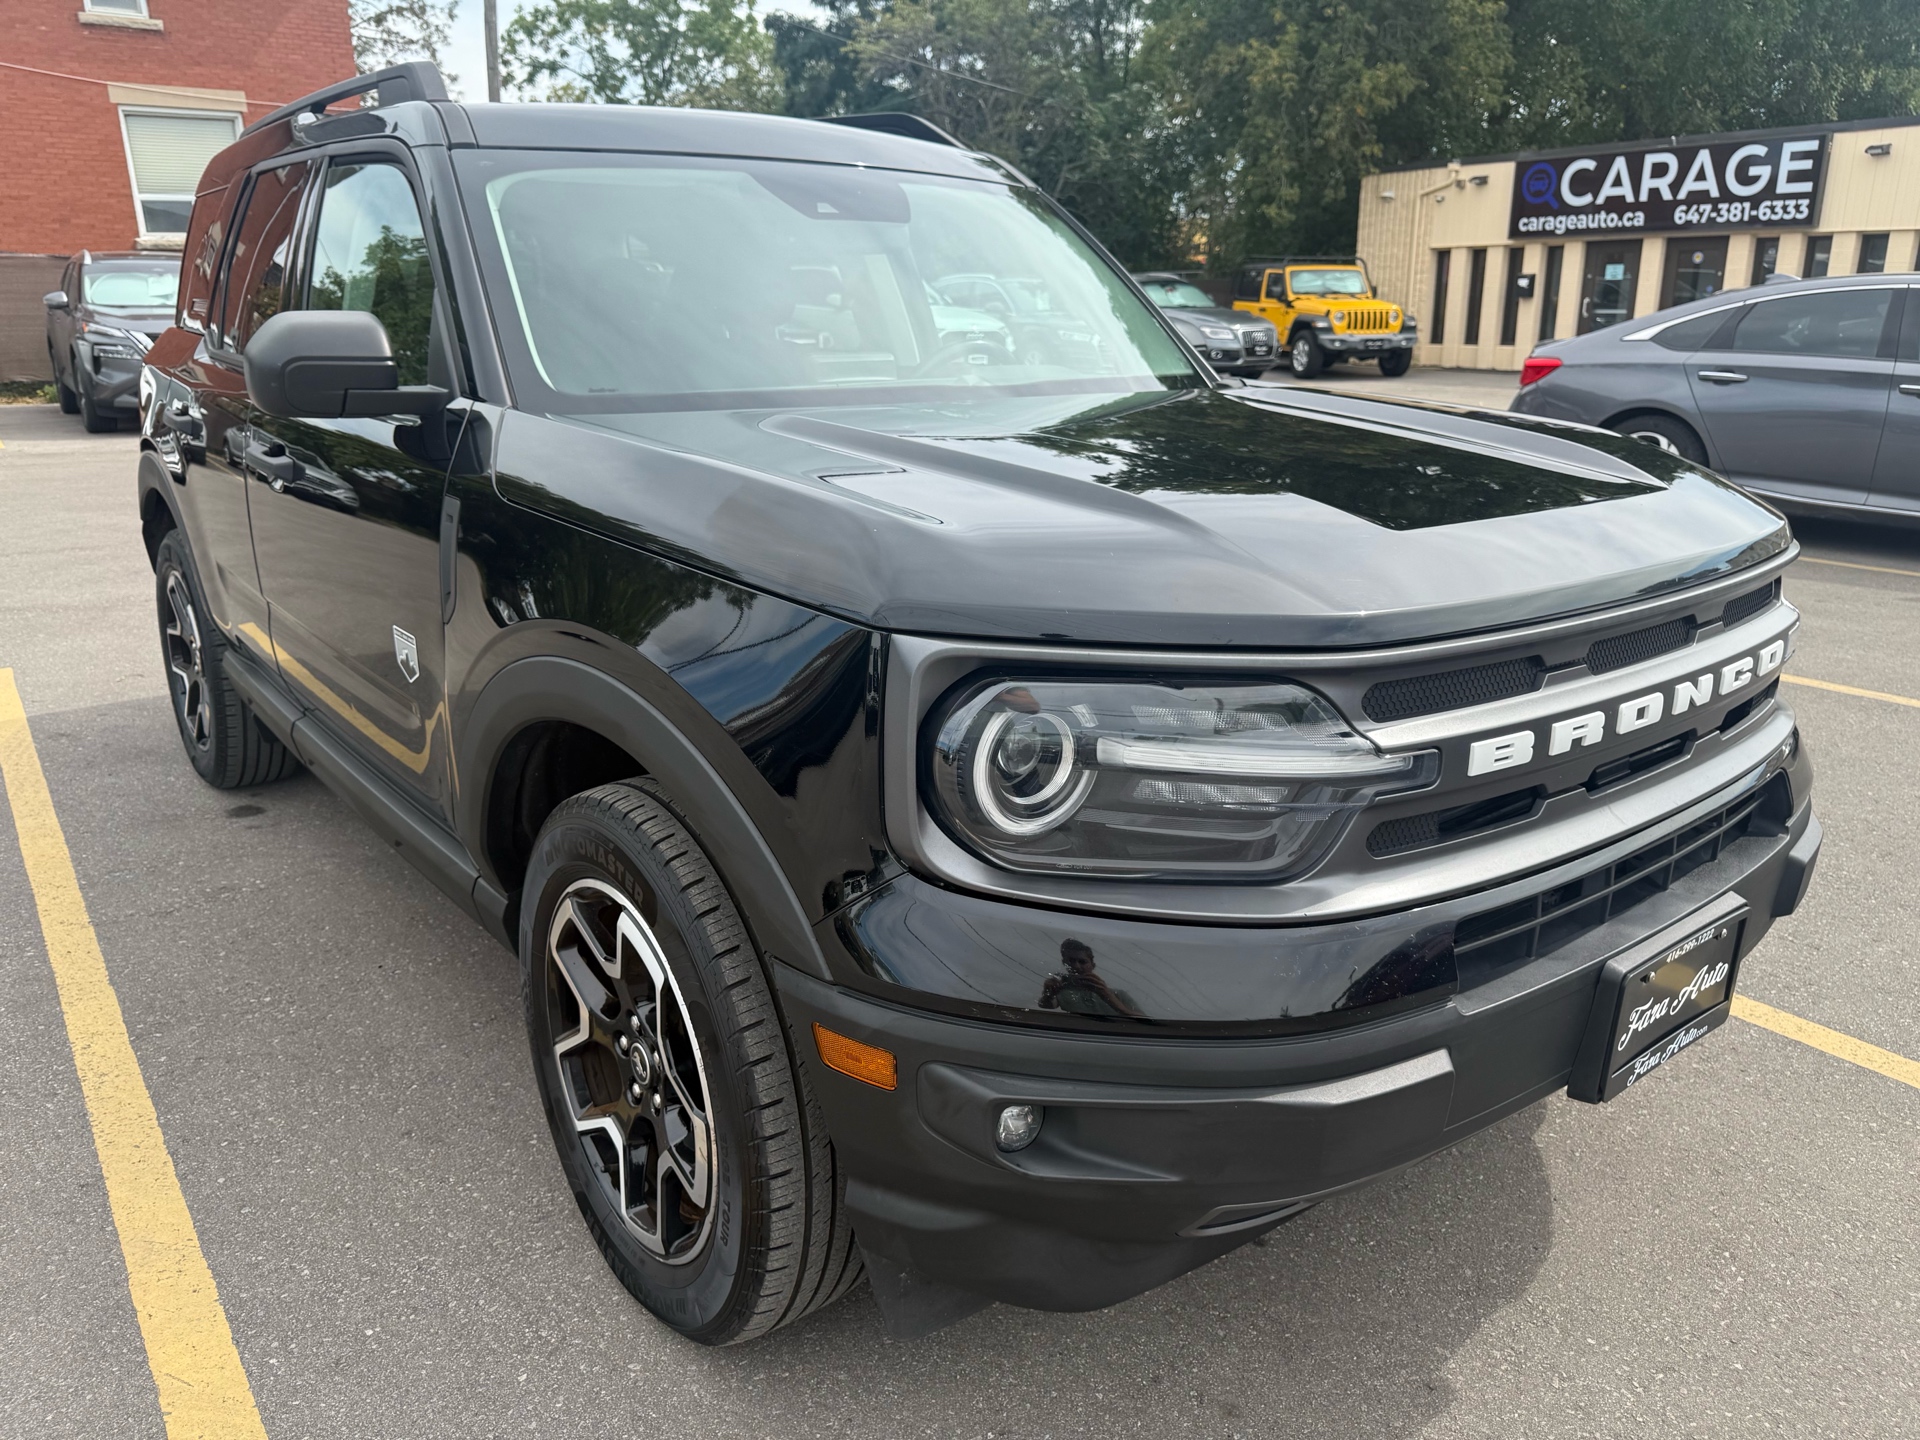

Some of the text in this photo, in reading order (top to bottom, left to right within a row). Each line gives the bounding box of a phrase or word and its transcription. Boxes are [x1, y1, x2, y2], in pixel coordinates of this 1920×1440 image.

[1518, 210, 1645, 235] carageauto.ca
[1673, 199, 1810, 225] 647-381-6333
[1467, 639, 1785, 777] BRONCO
[1669, 961, 1729, 1016] Auto
[1660, 1025, 1709, 1064] Auto.com
[718, 1200, 732, 1248] TOUR
